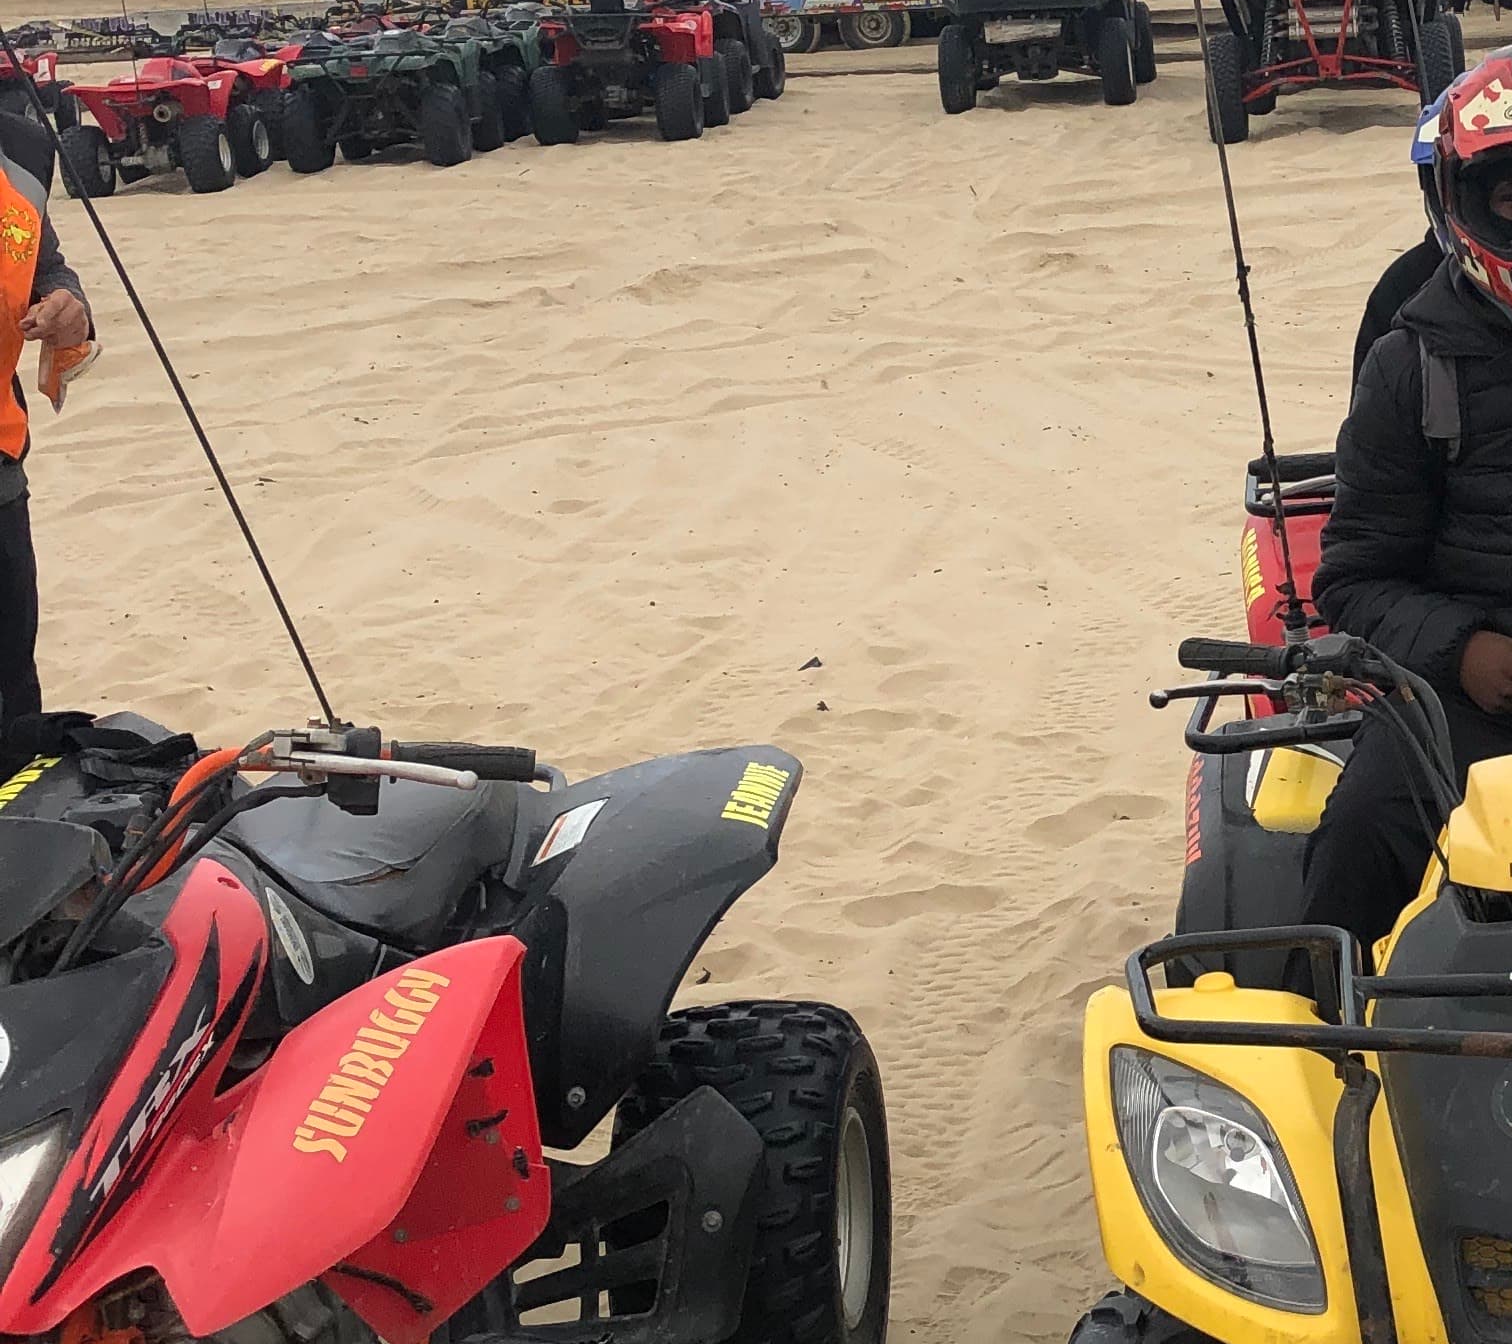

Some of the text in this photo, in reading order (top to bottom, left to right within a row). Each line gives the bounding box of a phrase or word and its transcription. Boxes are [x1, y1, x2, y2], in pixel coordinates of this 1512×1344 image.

[721, 761, 790, 830] JEANNIE
[89, 1003, 211, 1202] TRX
[292, 968, 451, 1164] SUNBUGGY
